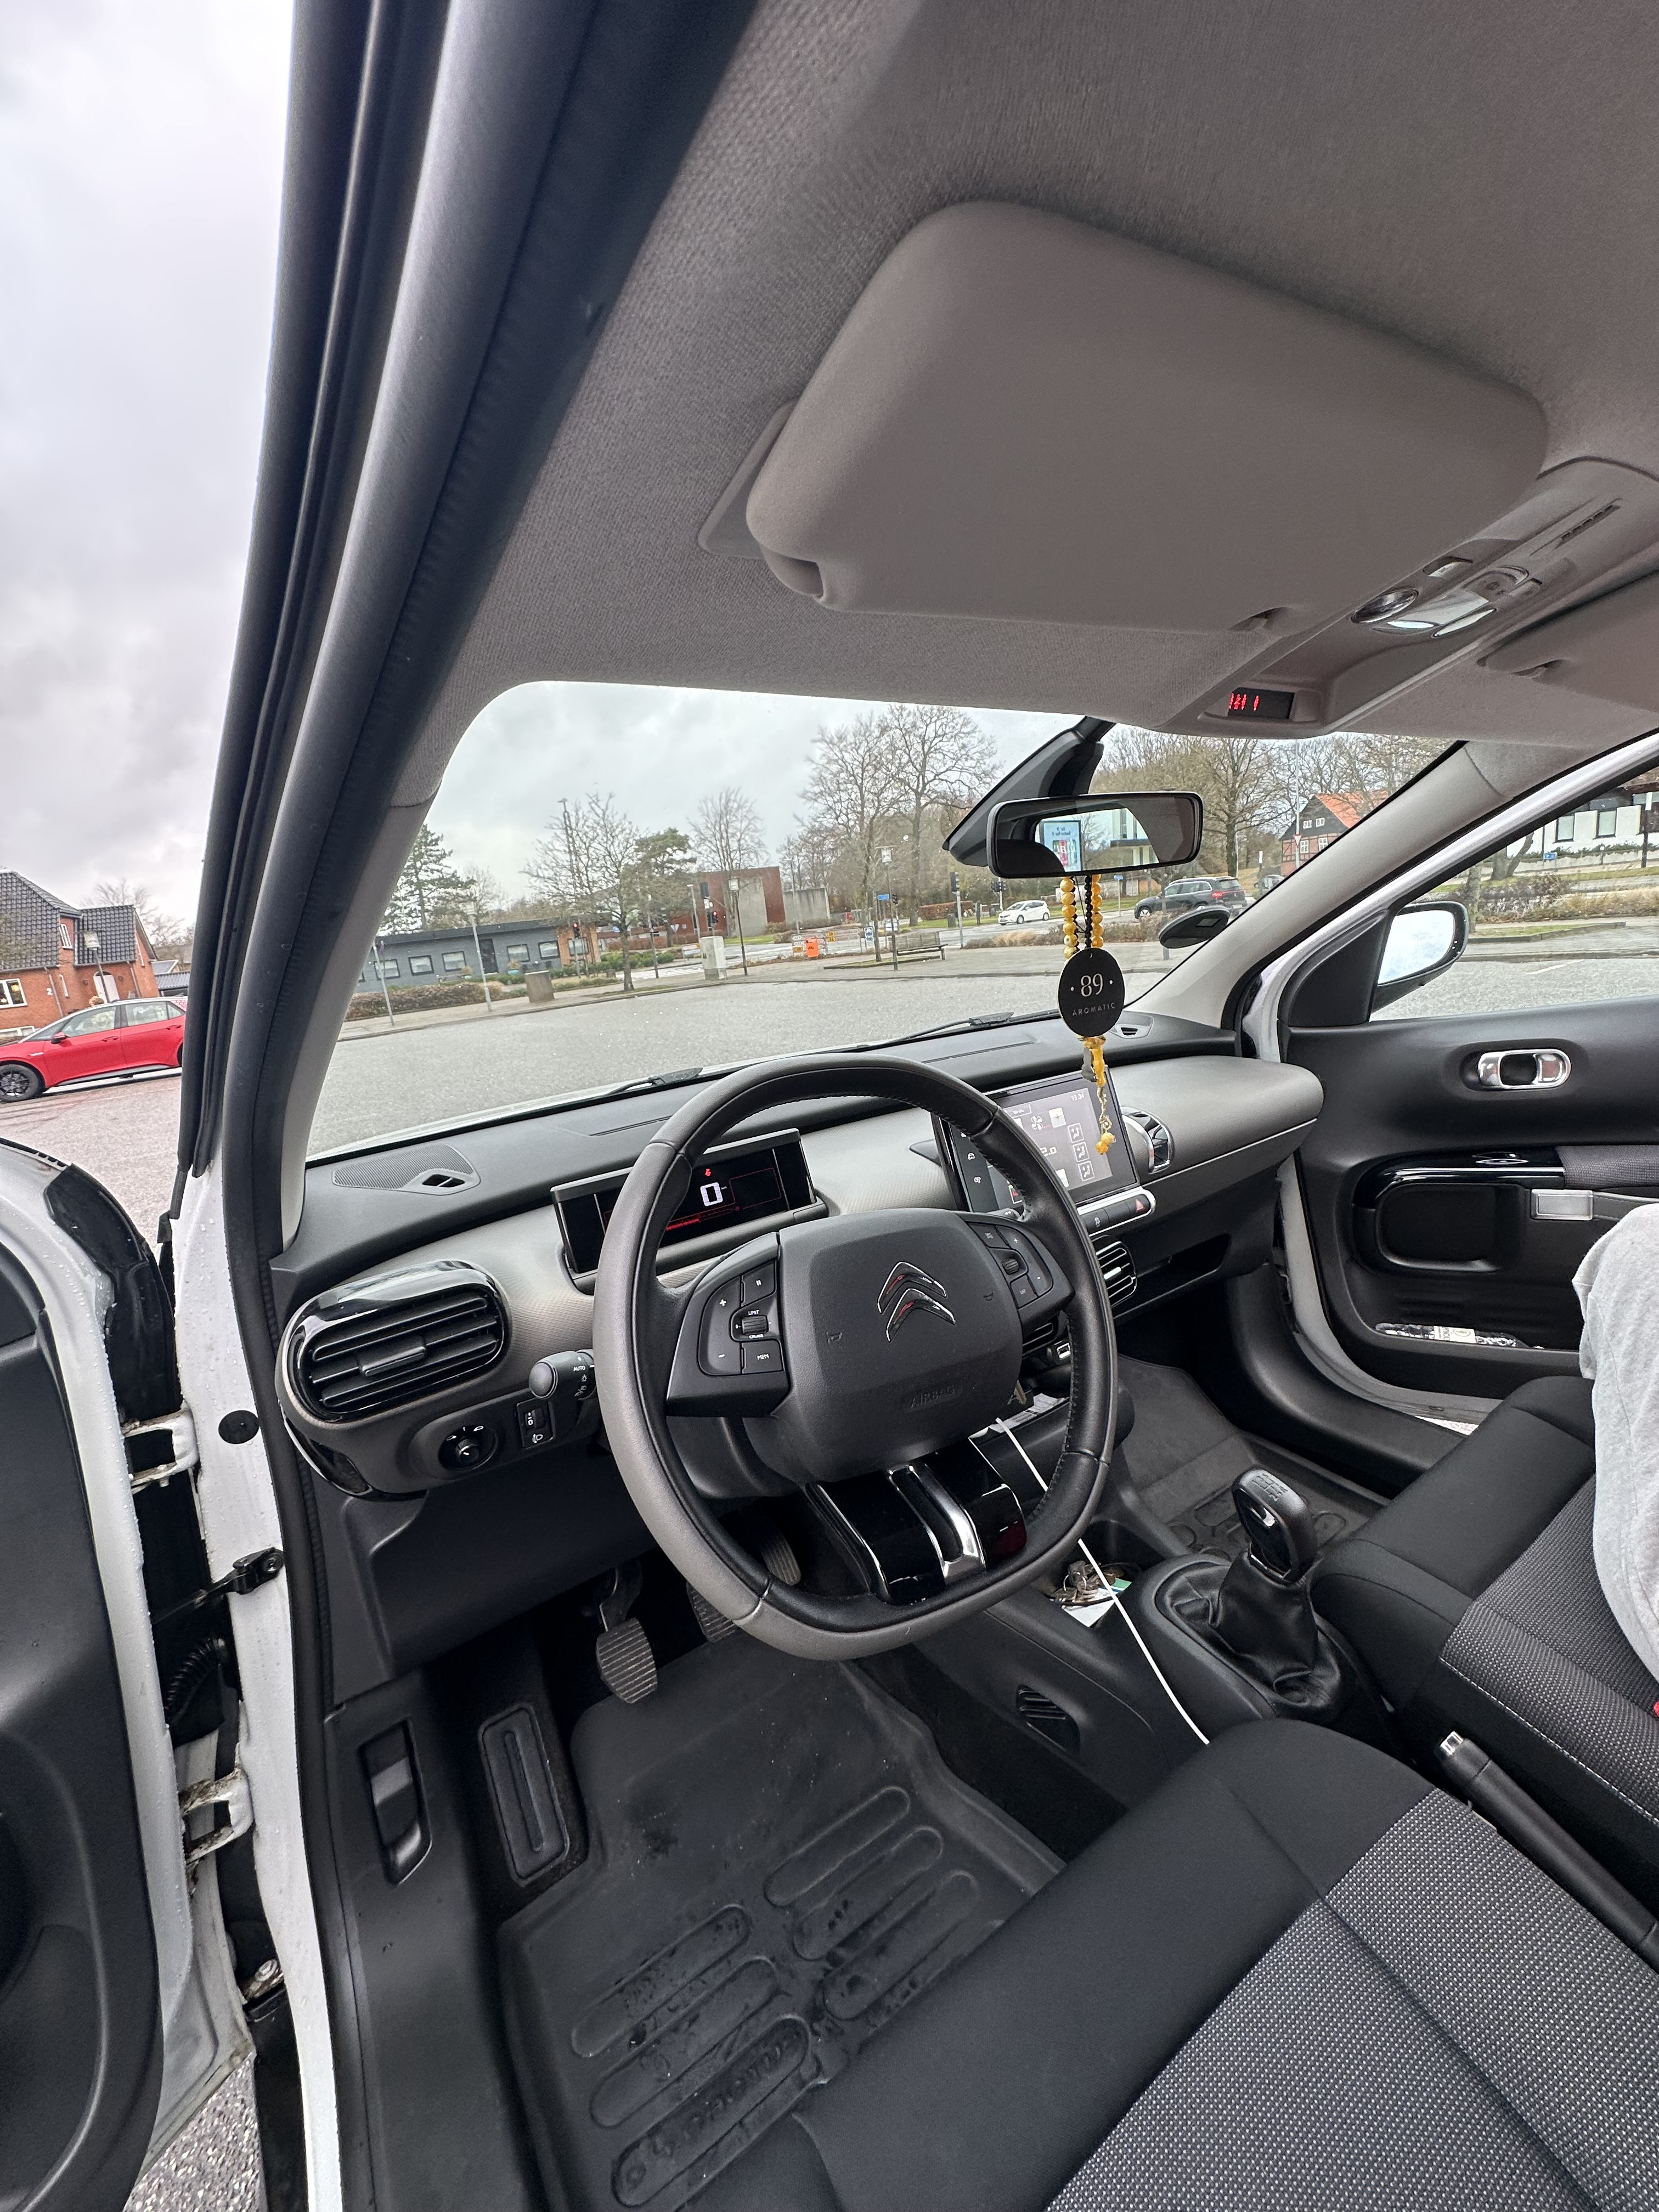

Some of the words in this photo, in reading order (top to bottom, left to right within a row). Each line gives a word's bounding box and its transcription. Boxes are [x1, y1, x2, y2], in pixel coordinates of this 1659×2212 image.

[1080, 973, 1103, 997] 89
[1072, 1002, 1115, 1016] AROMATIC
[700, 1182, 723, 1206] 0
